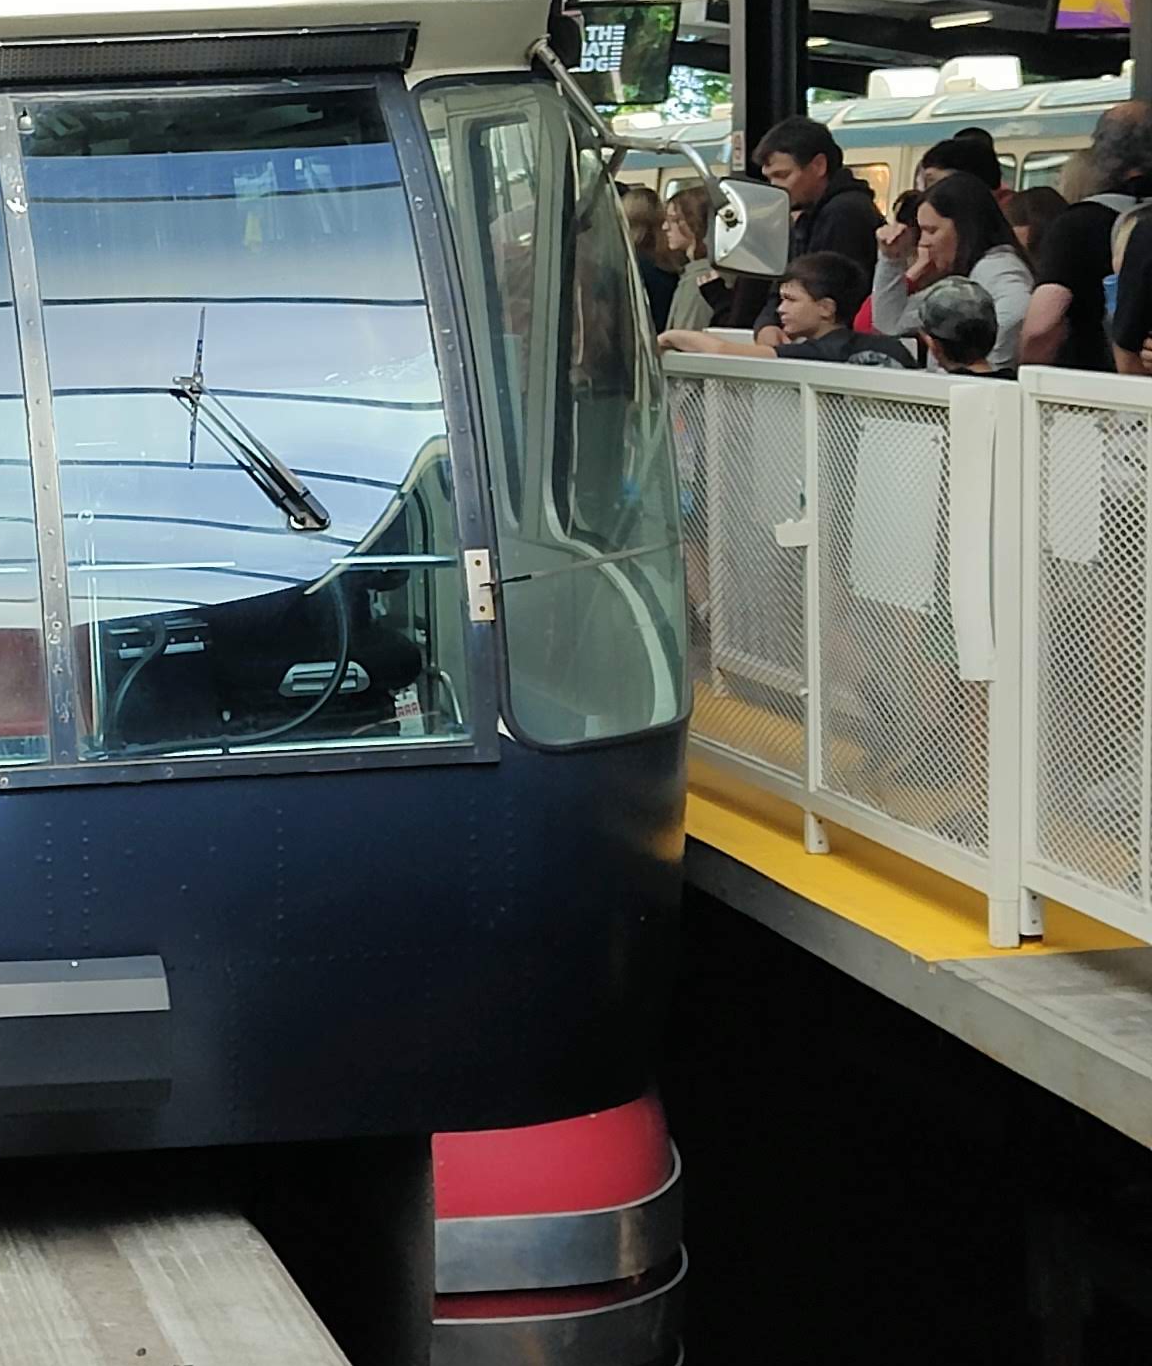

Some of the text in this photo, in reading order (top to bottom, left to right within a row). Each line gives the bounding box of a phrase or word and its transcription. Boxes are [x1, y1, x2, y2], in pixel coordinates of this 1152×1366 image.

[585, 24, 626, 42] THE
[581, 40, 624, 57] ATE
[580, 56, 622, 72] DGE
